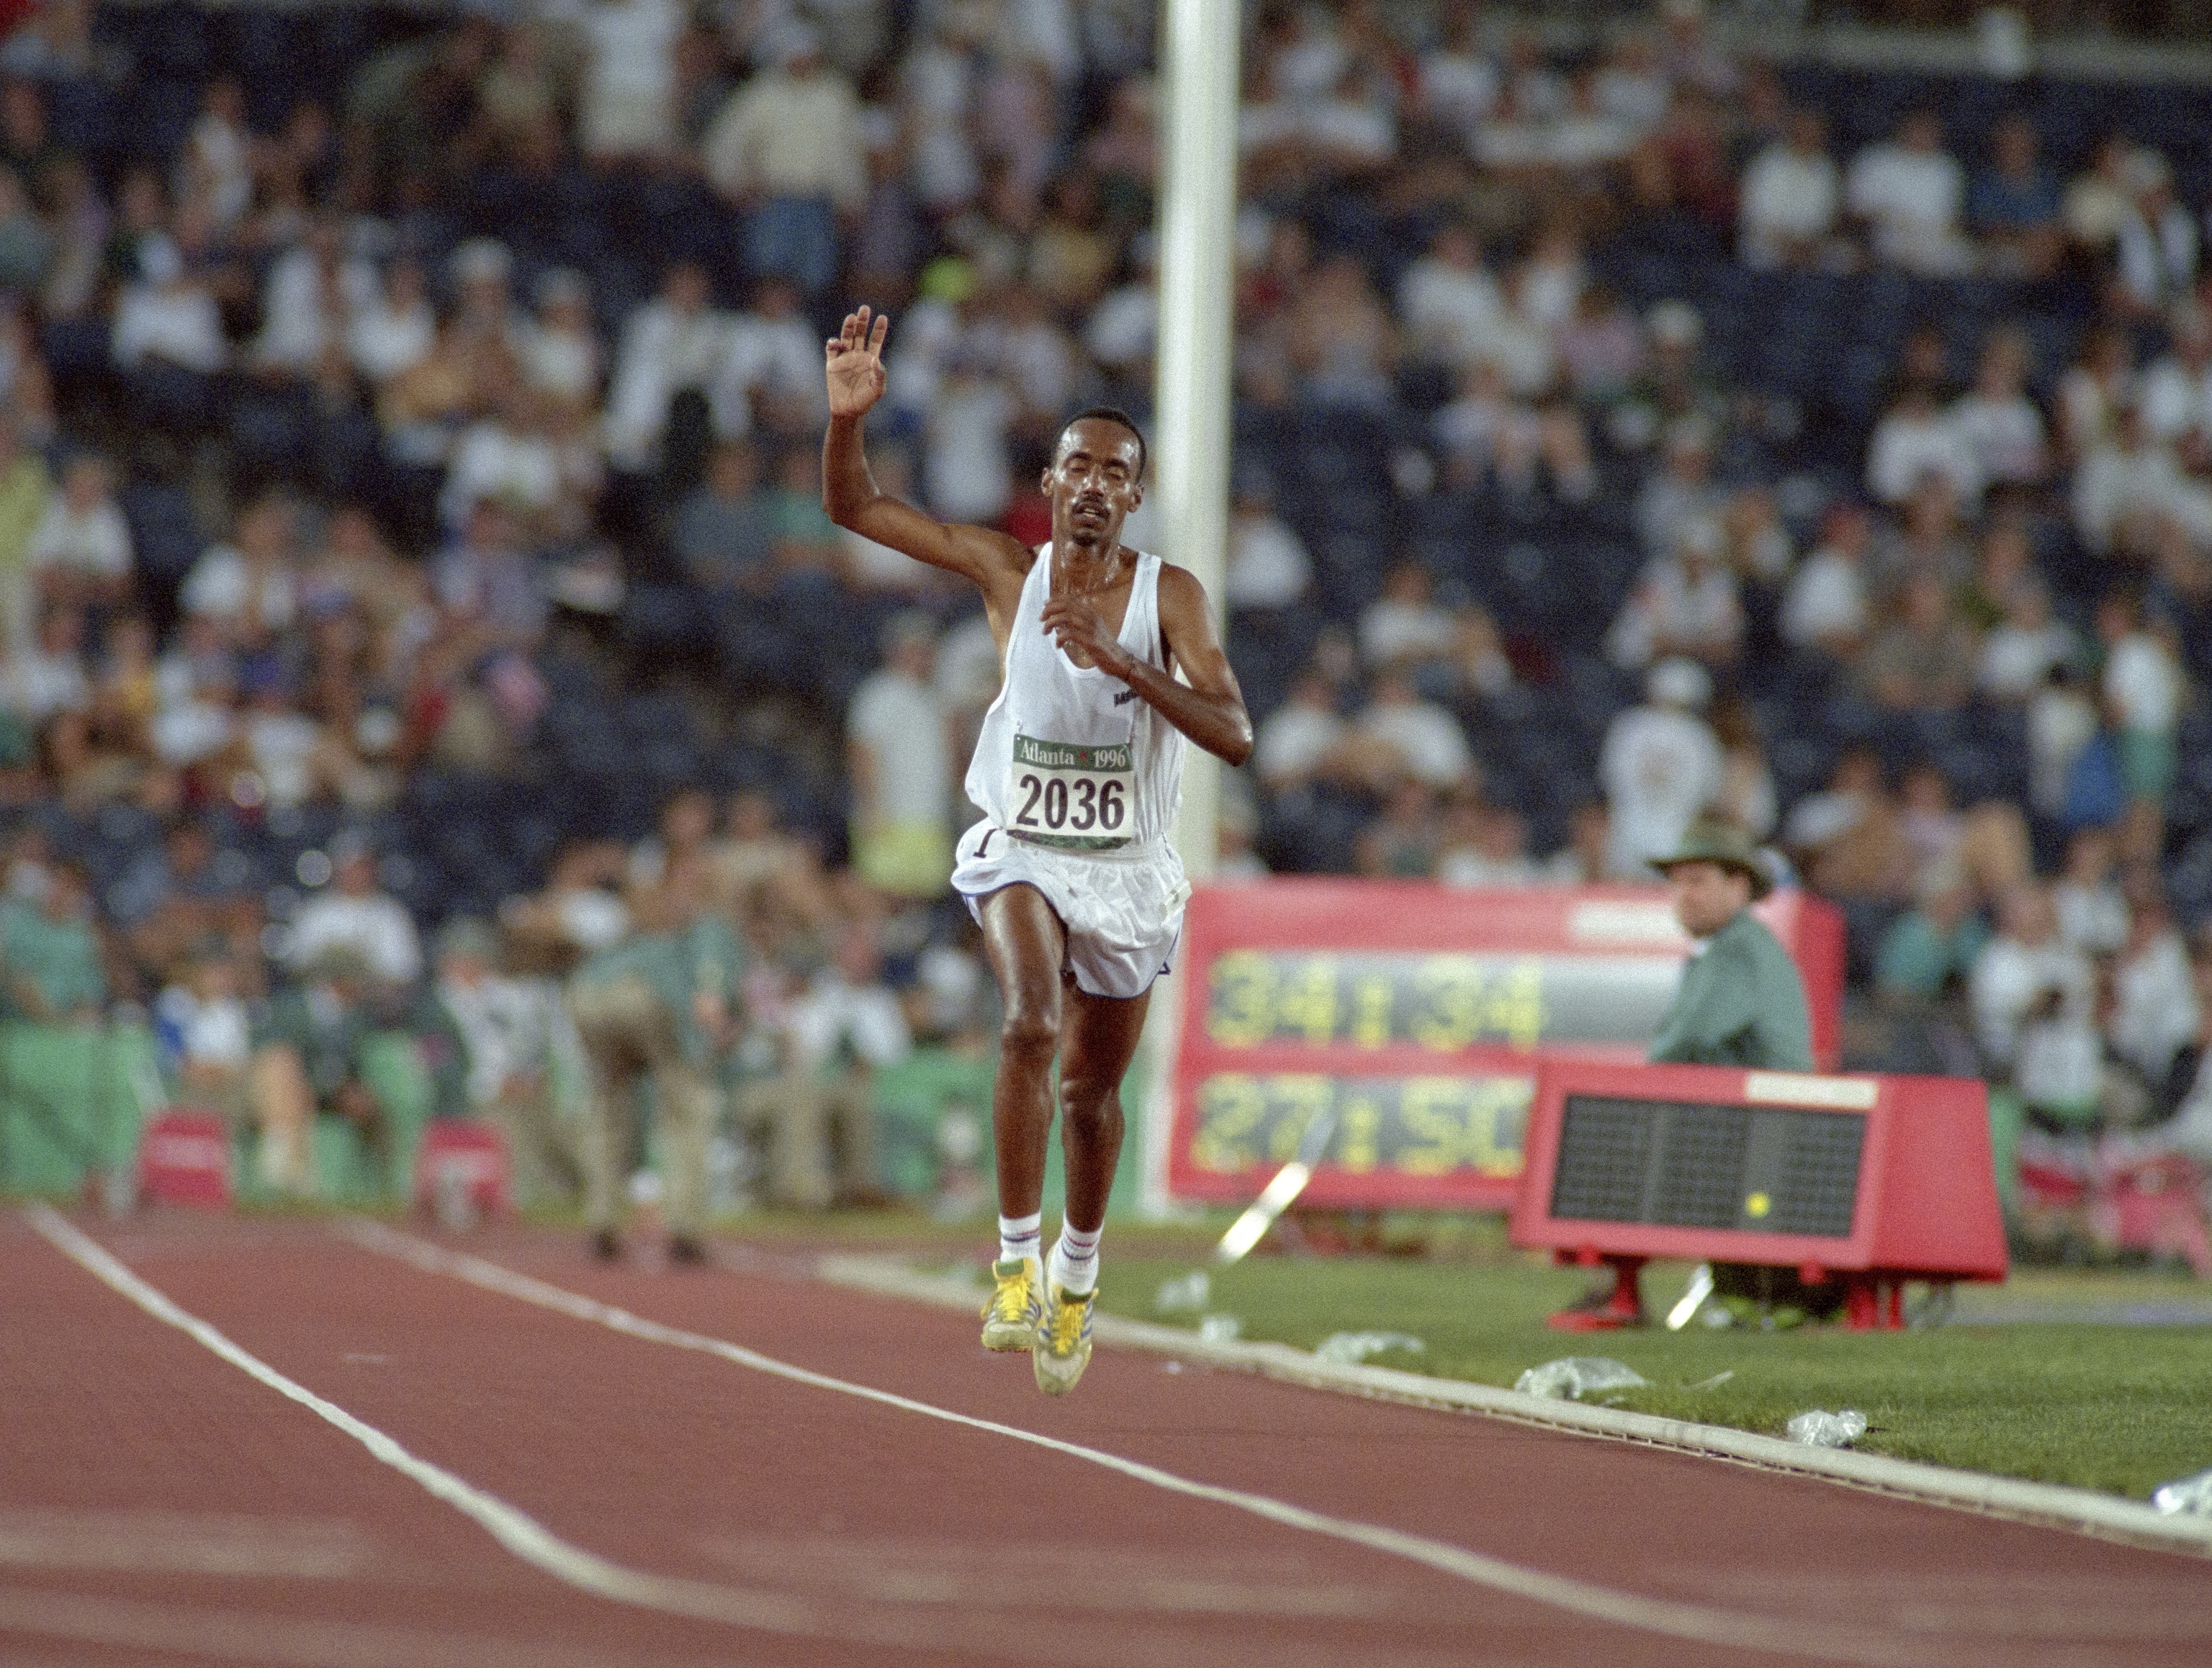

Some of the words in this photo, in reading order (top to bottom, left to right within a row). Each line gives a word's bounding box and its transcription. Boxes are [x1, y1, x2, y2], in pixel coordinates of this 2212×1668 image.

[1020, 739, 1075, 765] Atlanta
[1093, 747, 1126, 768] 1996
[1016, 774, 1125, 830] 2036
